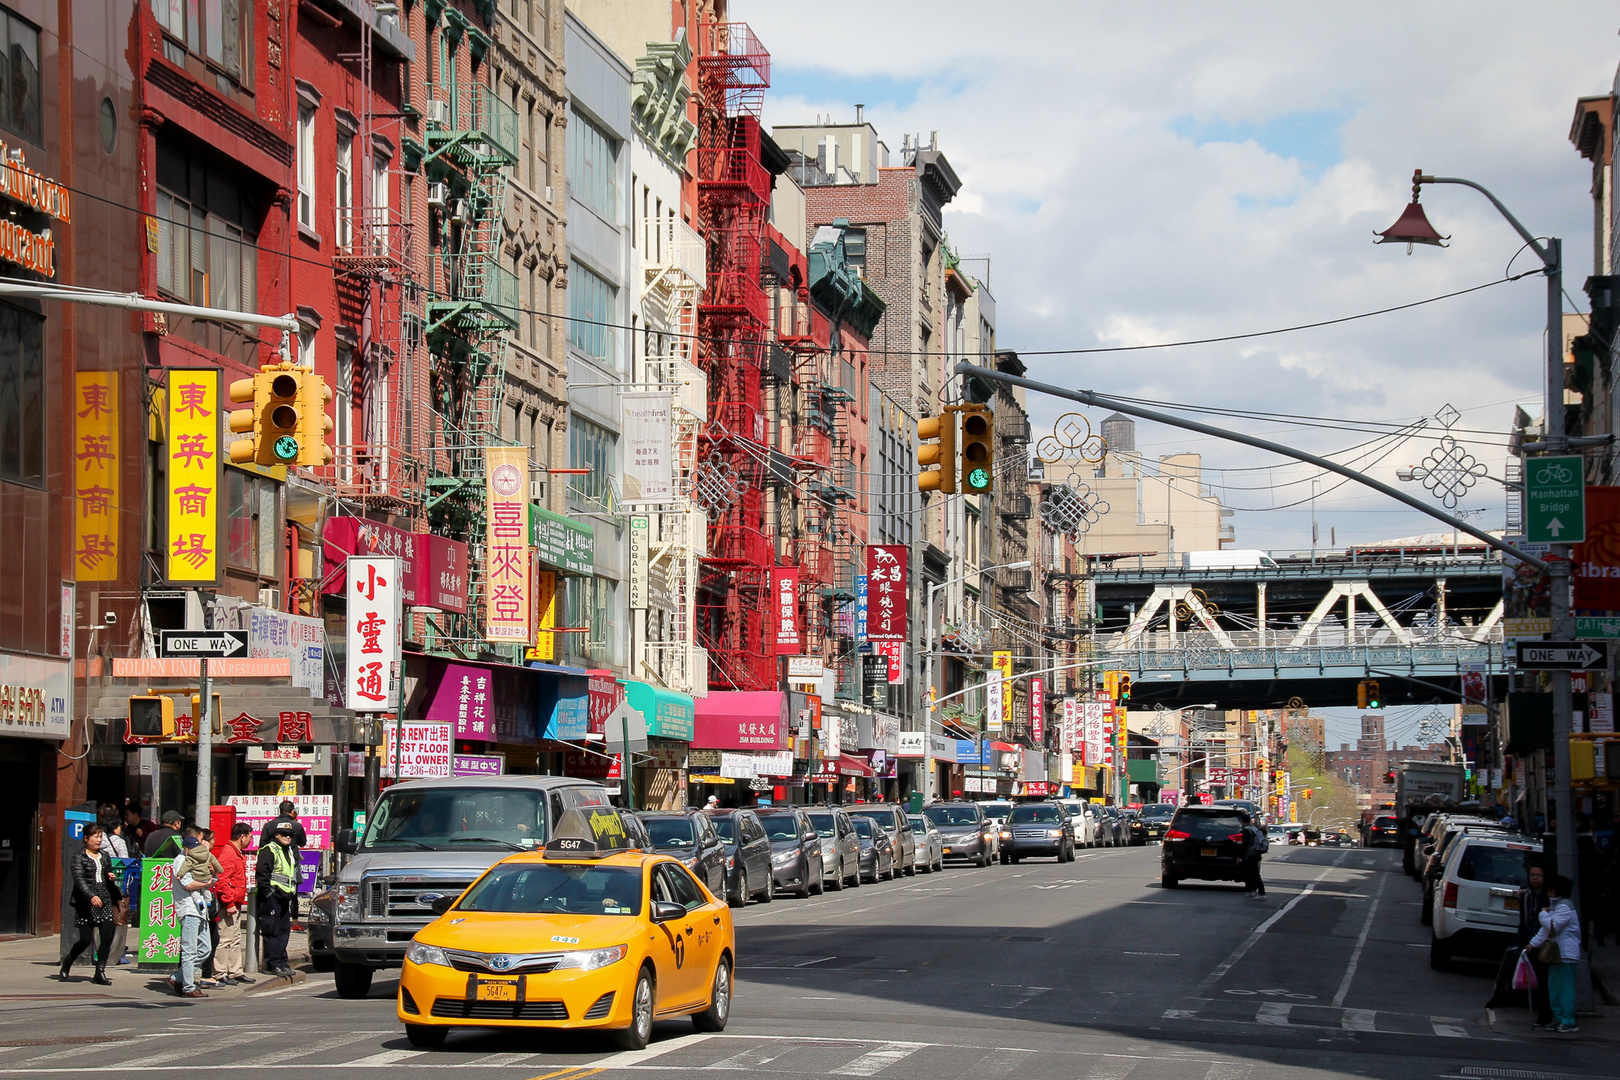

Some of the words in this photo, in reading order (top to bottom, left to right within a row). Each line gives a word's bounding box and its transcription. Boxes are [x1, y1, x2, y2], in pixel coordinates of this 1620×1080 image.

[632, 409, 666, 418] healthfirst
[172, 382, 214, 570] 東英商場
[1531, 488, 1579, 499] Manhattan
[1540, 503, 1570, 513] Bridge
[491, 501, 524, 623] 喜來登
[871, 565, 902, 583] 永昌
[1576, 562, 1620, 578] ibra
[780, 579, 796, 632] 安聯保險
[878, 582, 894, 632] 眼鏡公司
[355, 563, 387, 702] 小靈通
[174, 640, 199, 650] ONE
[210, 640, 235, 650] WAY
[1529, 650, 1555, 661] ONE
[1567, 650, 1594, 661] WAY
[116, 660, 167, 676] GOLDEN
[171, 659, 226, 676] UNICRN
[229, 662, 289, 676] RESTAURANT
[51, 697, 65, 713] ATM
[409, 728, 429, 740] RENT
[430, 726, 449, 741] 出租
[739, 736, 749, 744] JSM
[749, 736, 775, 744] BUILDING
[391, 743, 416, 752] FRST
[419, 744, 448, 753] FLOOR
[416, 756, 449, 765] OWNER
[390, 766, 448, 776] 37-236-6312
[74, 823, 84, 838] P
[560, 840, 581, 850] 5G47
